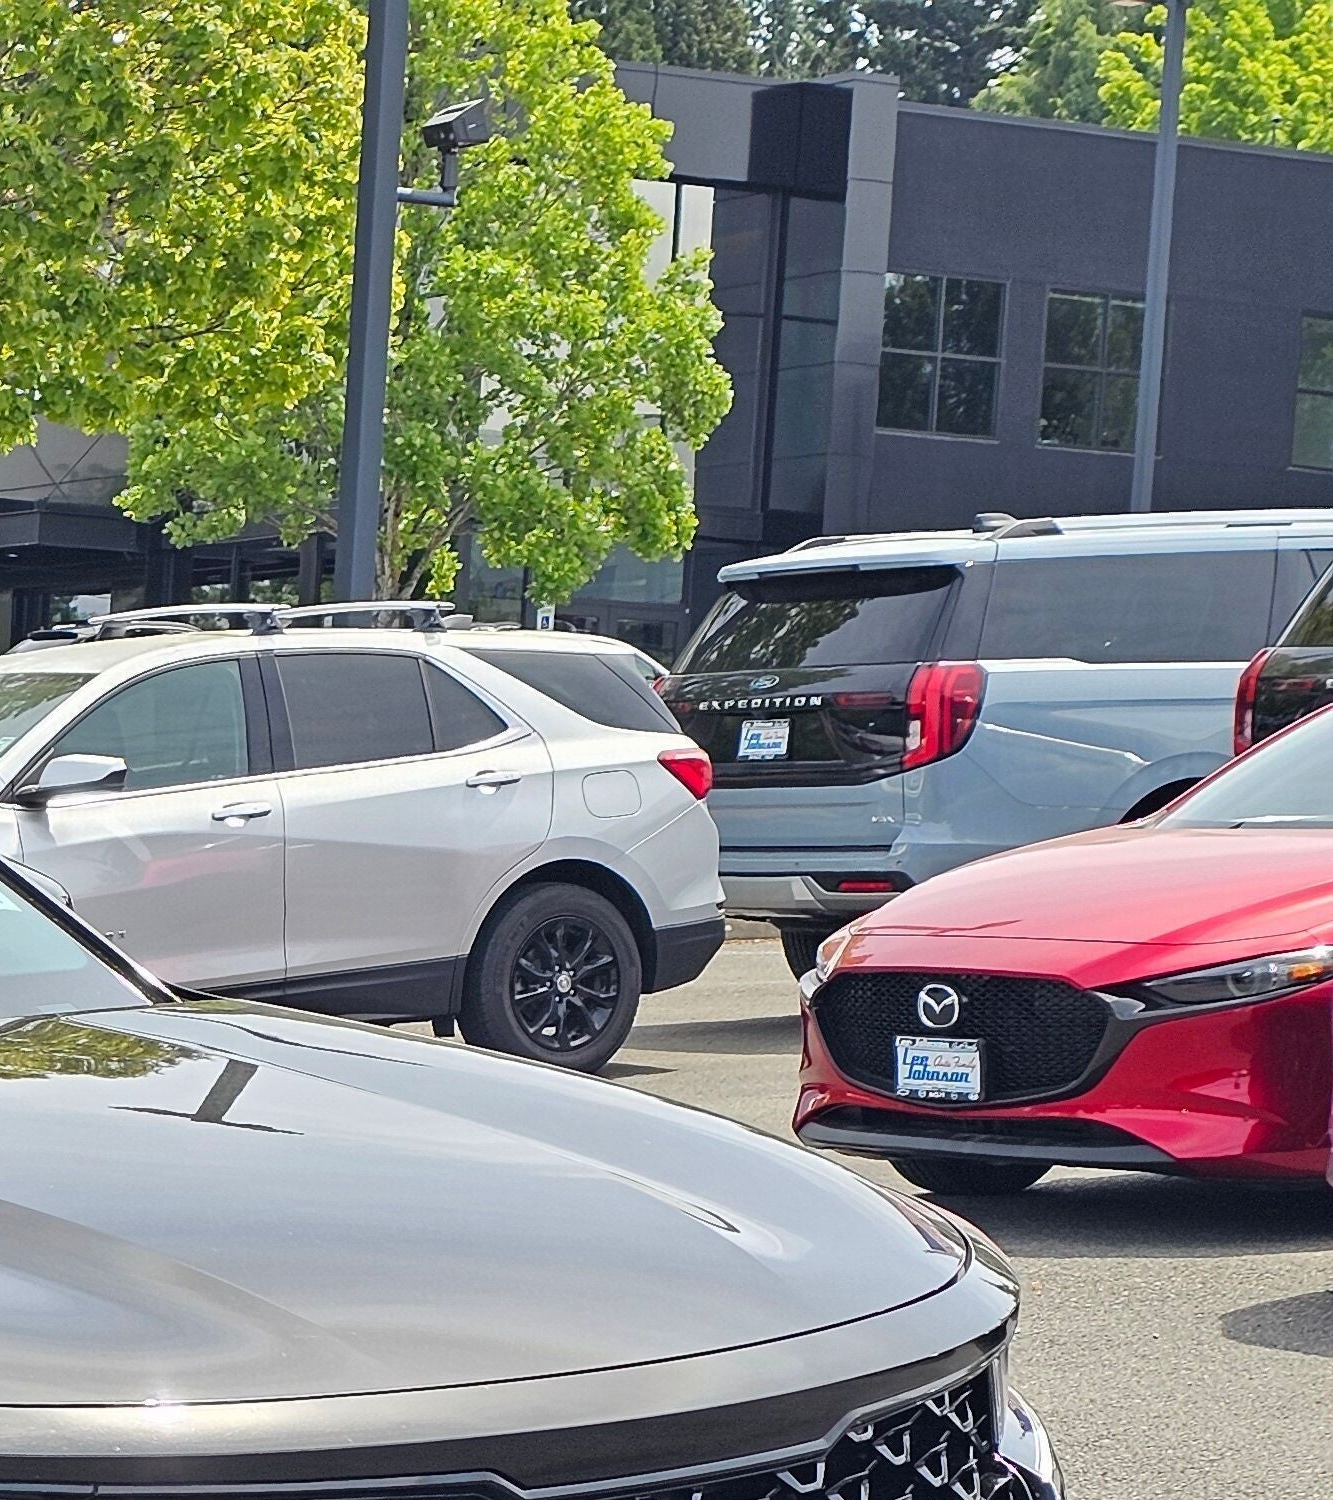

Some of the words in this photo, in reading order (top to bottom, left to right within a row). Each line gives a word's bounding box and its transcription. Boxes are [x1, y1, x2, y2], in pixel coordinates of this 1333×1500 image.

[698, 696, 822, 710] EXPEDITION
[902, 1047, 931, 1067] Lee
[903, 1065, 972, 1083] Johnson
